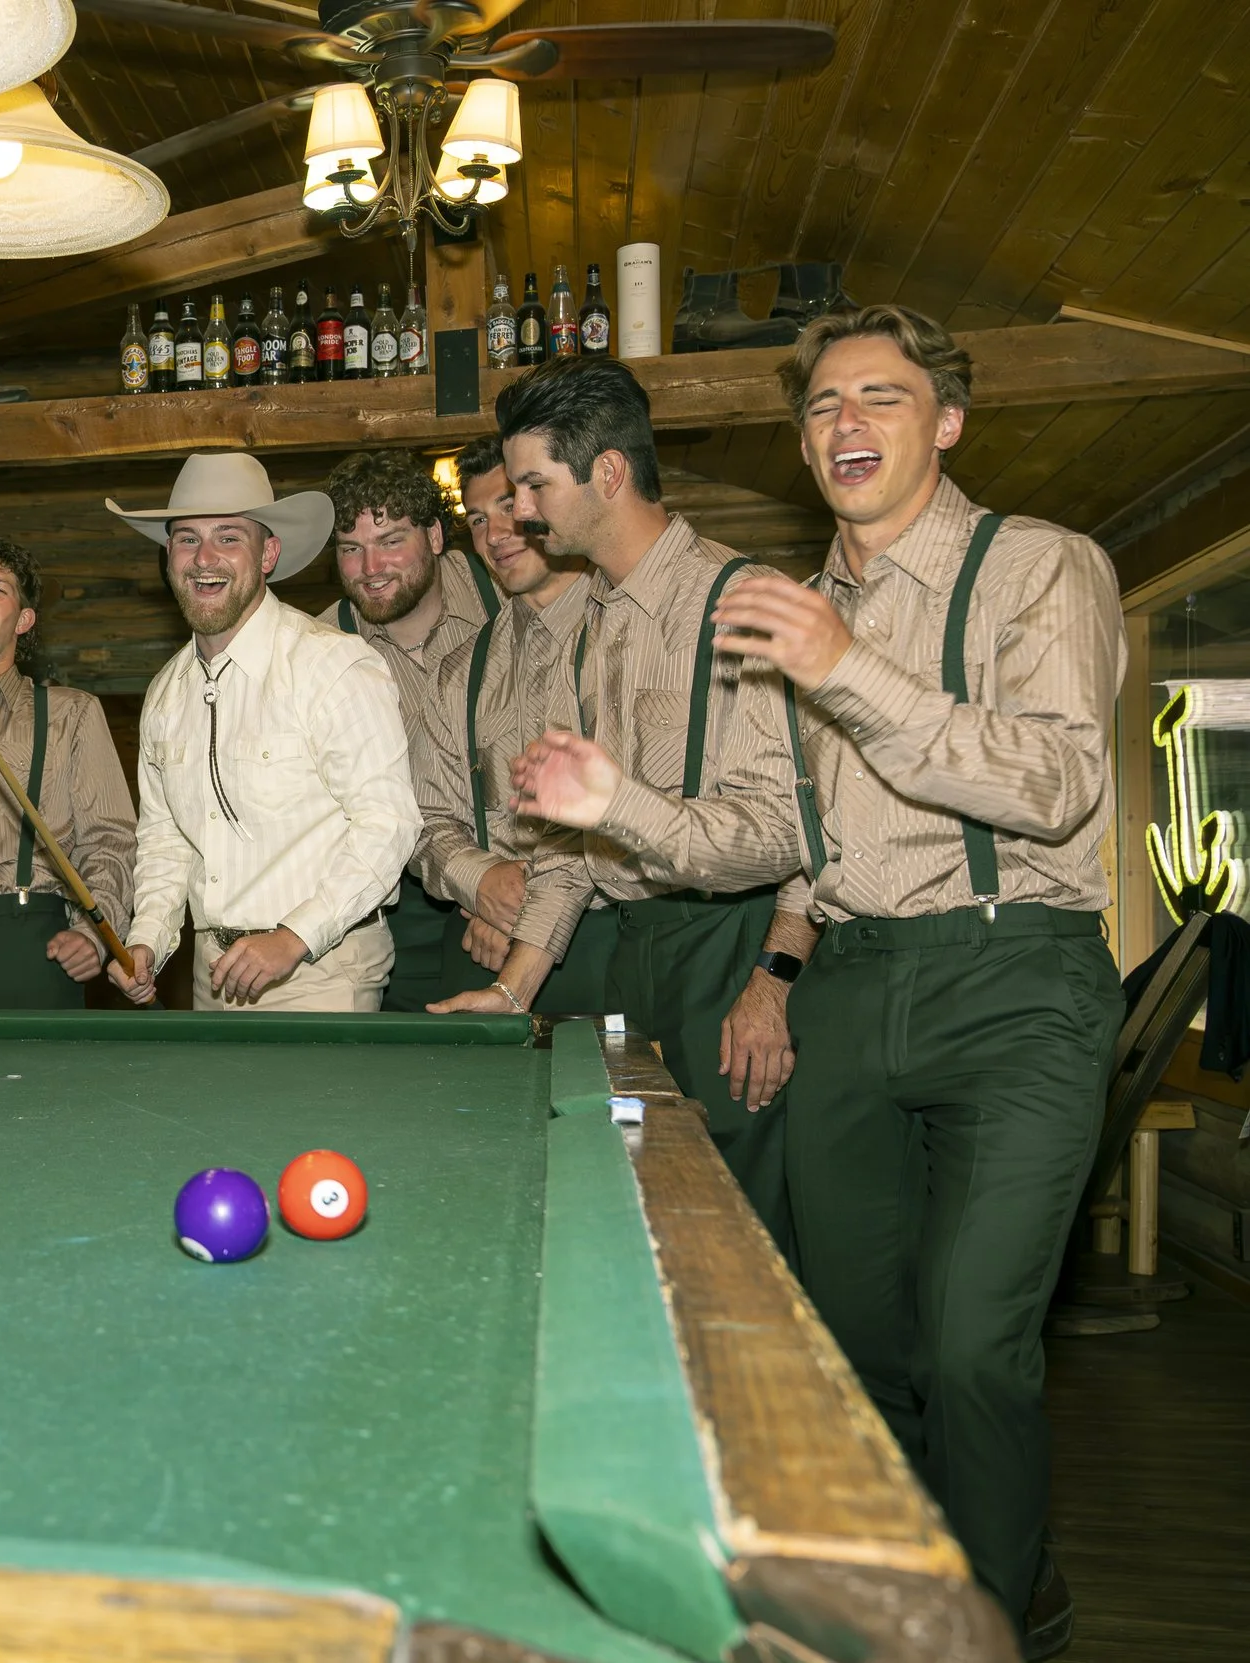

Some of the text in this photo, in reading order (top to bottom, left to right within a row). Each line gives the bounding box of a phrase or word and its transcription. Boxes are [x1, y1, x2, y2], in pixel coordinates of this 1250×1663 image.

[489, 332, 514, 341] FERRET
[555, 335, 575, 350] IPA
[236, 353, 255, 367] FOOT
[321, 1191, 340, 1206] 3
